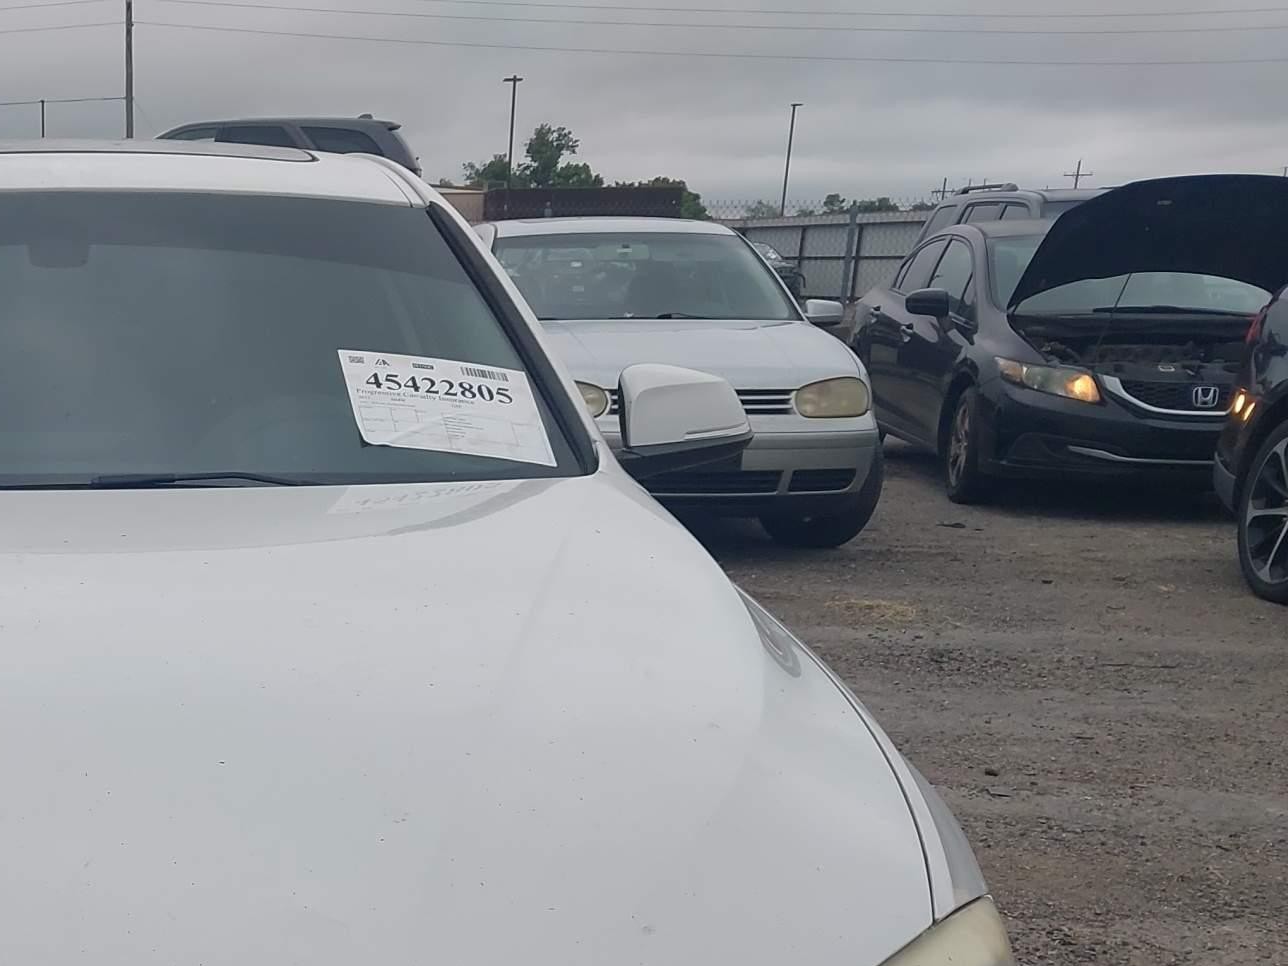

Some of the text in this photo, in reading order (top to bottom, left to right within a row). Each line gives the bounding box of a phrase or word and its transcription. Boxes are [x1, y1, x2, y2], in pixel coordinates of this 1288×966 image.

[356, 388, 402, 396] Progressive
[402, 391, 436, 401] Casualty
[438, 394, 476, 404] Insurance
[365, 371, 513, 404] 45422805
